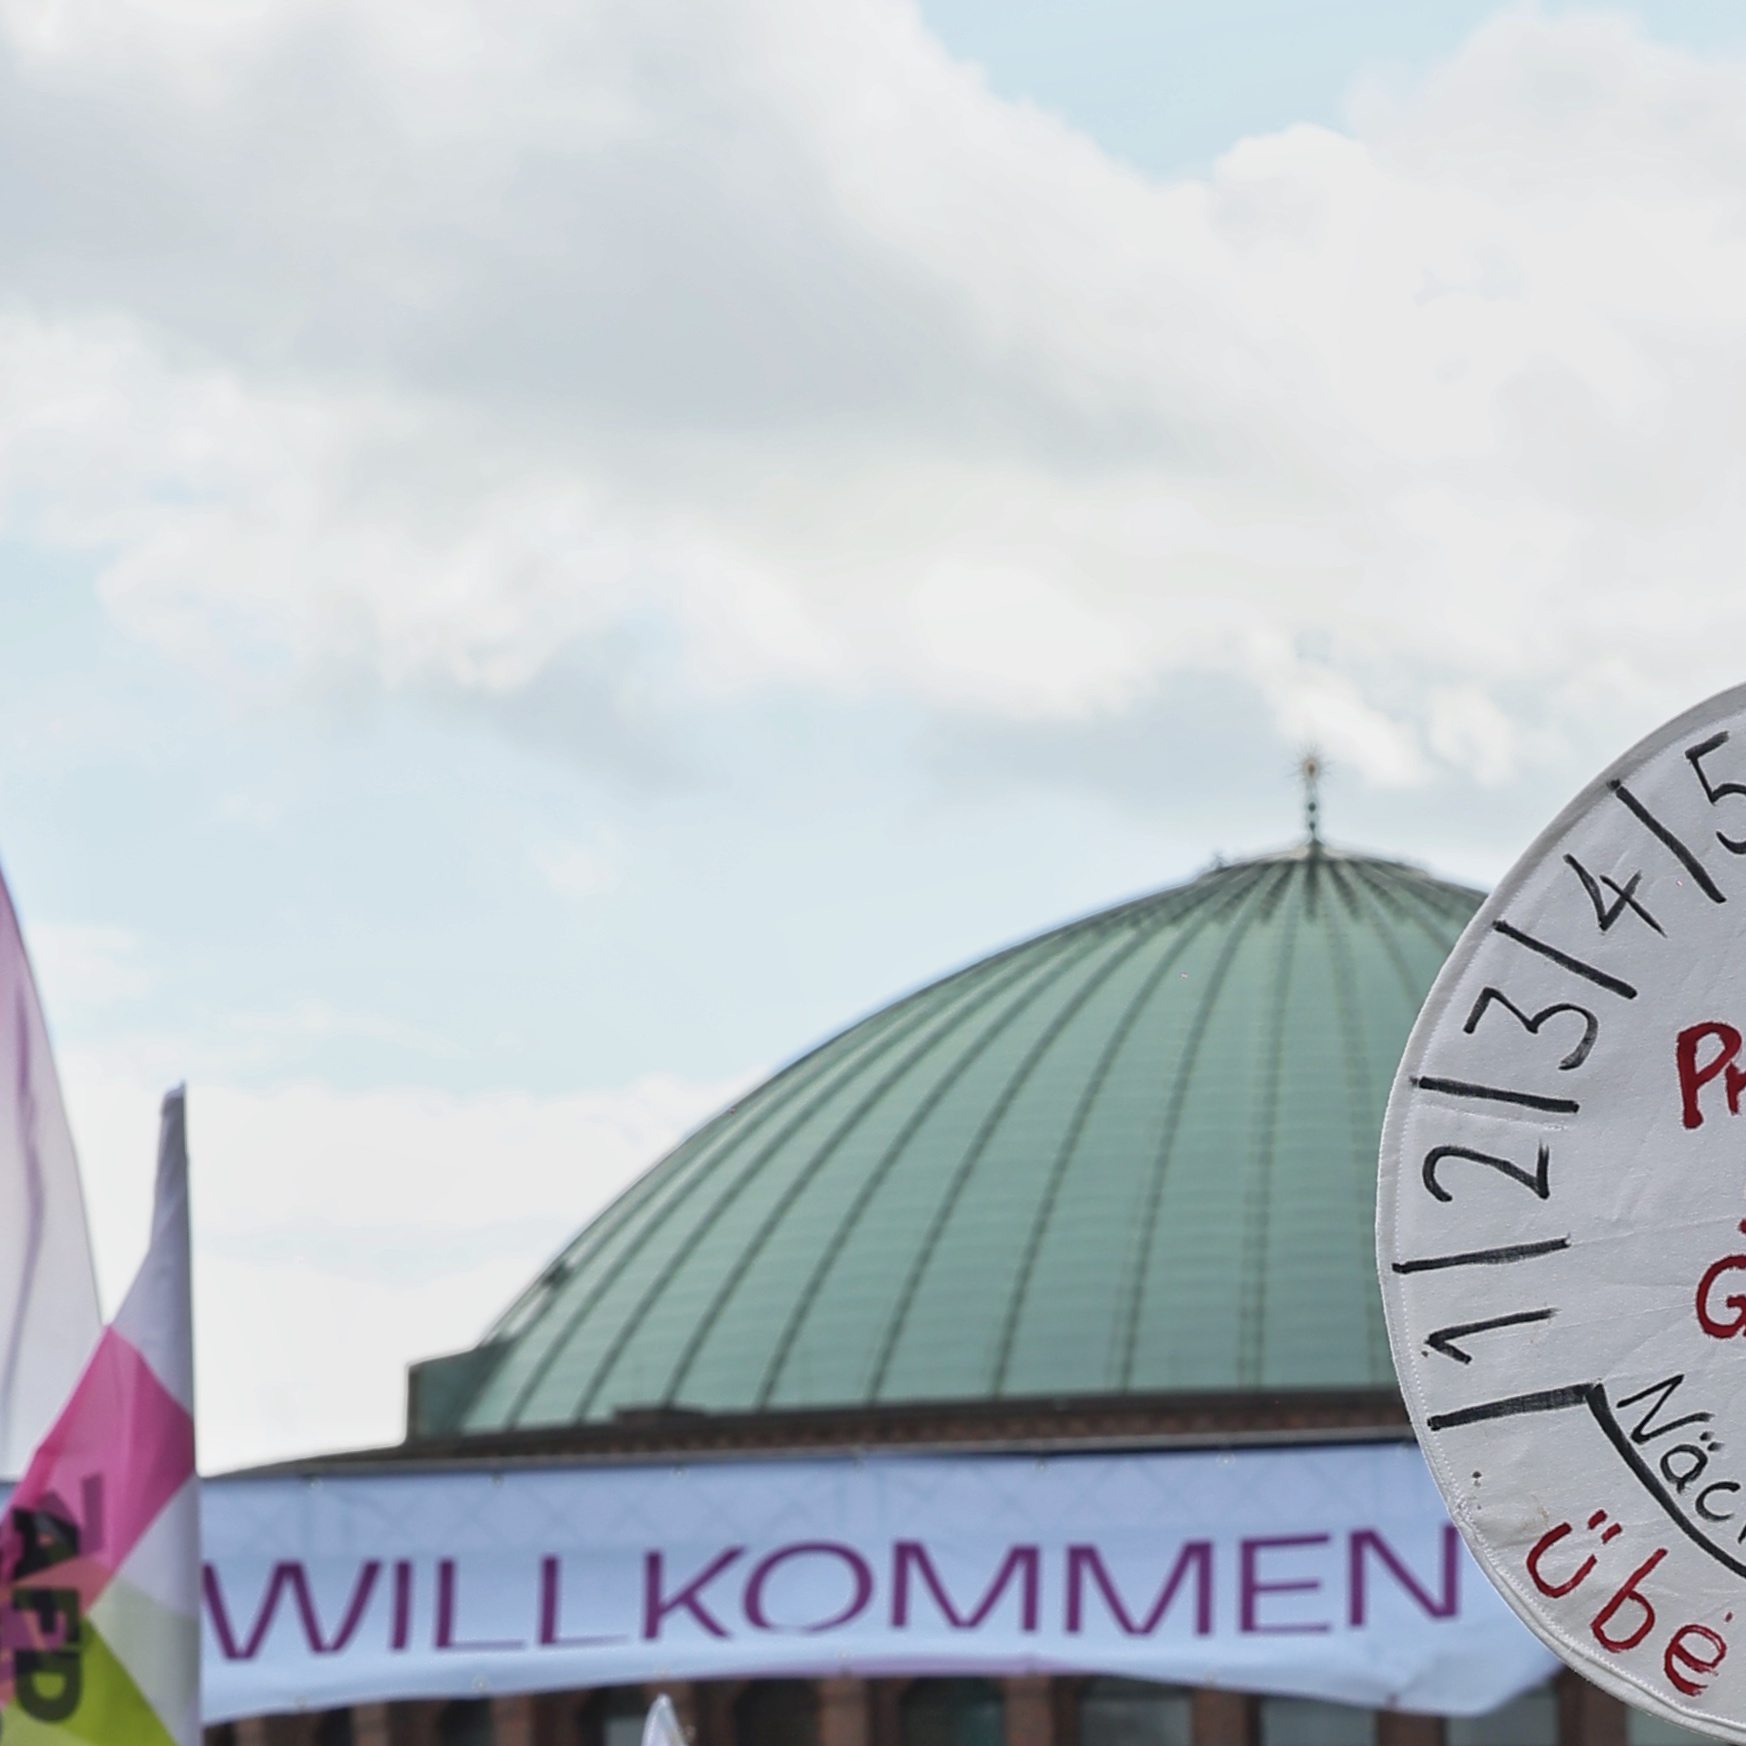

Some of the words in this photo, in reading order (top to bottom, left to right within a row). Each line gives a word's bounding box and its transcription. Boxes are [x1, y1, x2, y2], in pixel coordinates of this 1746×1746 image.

[1564, 853, 1665, 936] 4
[1464, 987, 1598, 1071] 3
[1422, 1146, 1551, 1202] 2
[1422, 1309, 1553, 1364] 1
[203, 1525, 1460, 1659] WILLKOMMEN
